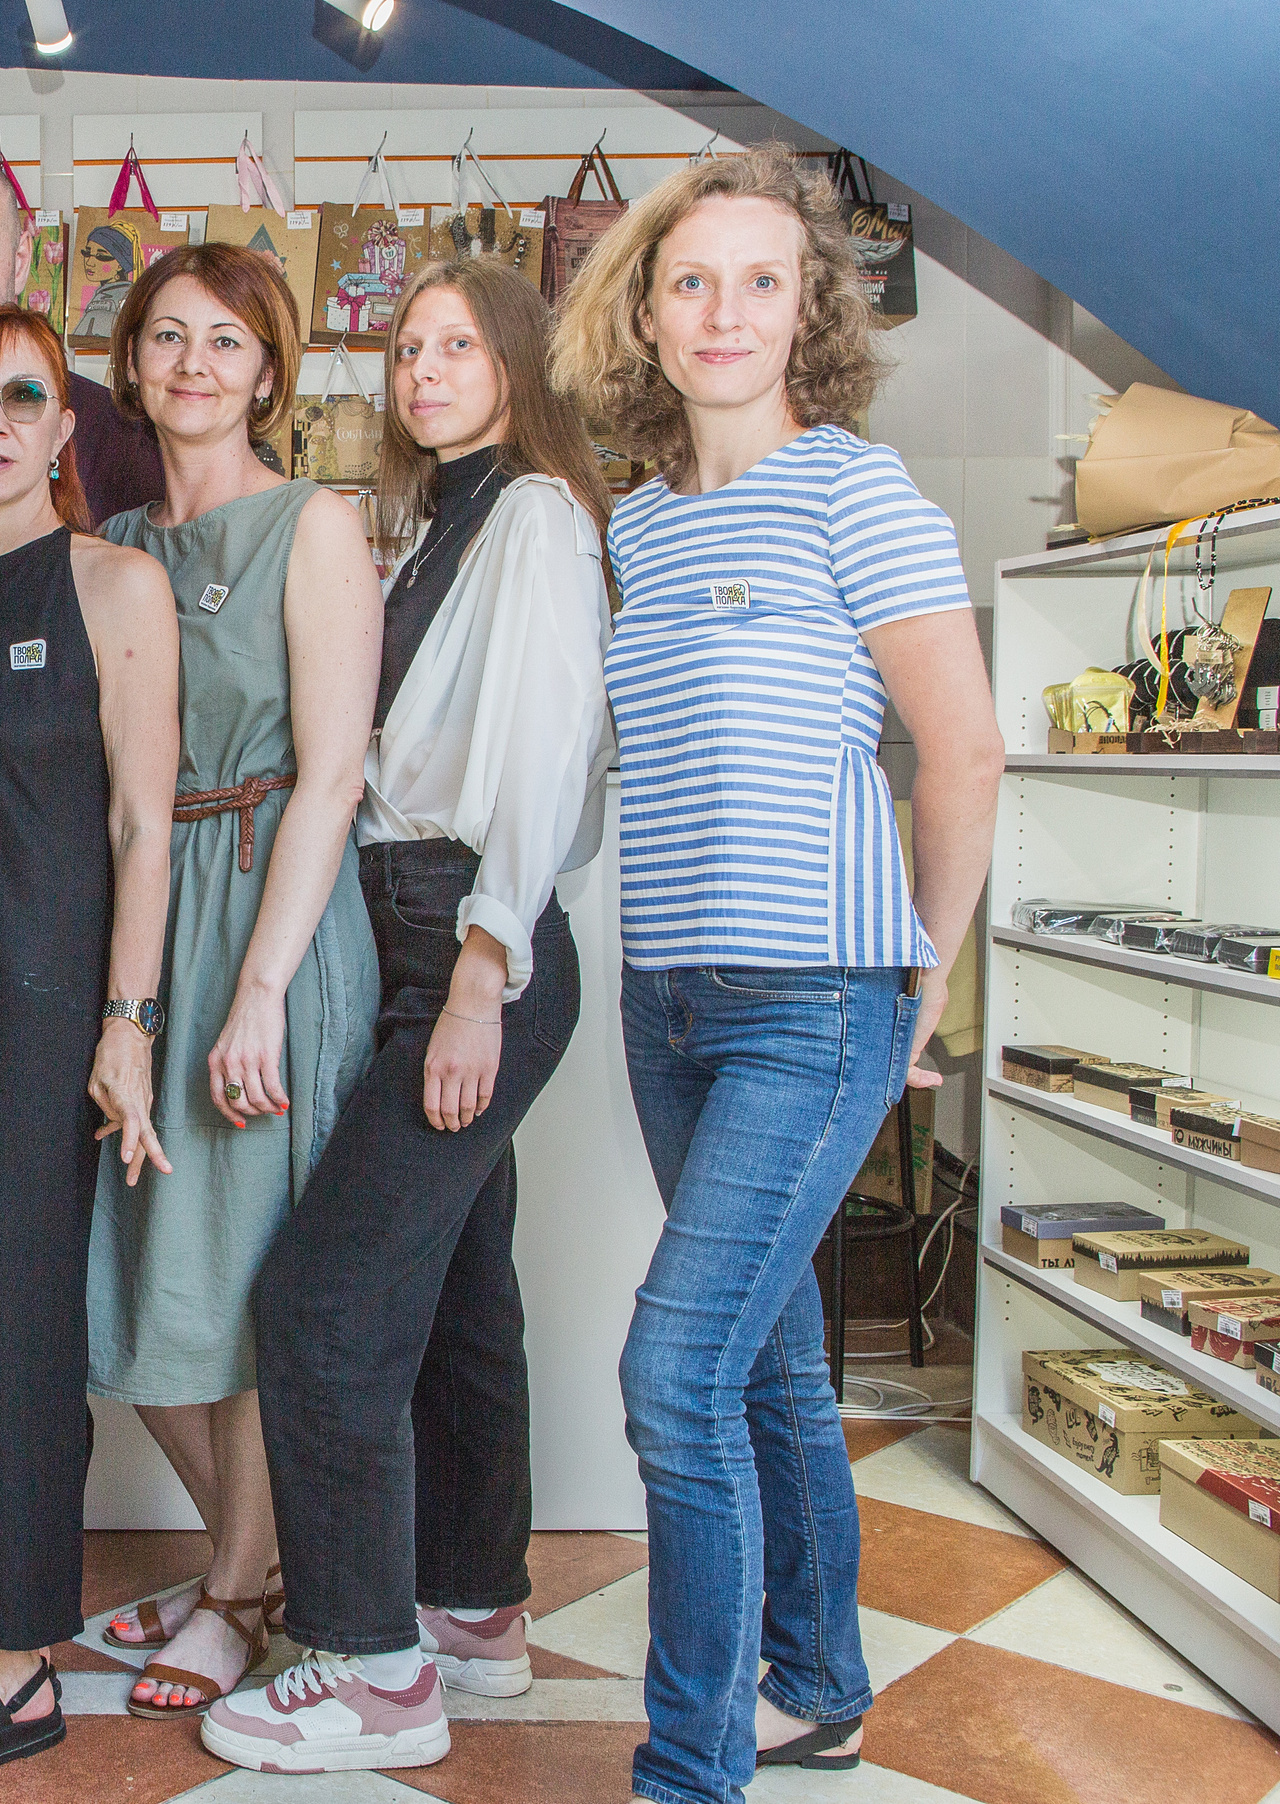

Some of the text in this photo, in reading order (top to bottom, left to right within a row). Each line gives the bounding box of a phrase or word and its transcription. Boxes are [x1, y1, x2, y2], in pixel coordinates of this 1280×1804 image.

[713, 586, 733, 596] ТВОЯ
[715, 595, 746, 605] ПОЛКА
[13, 645, 31, 655] ТВОЯ
[1188, 1134, 1232, 1158] МУЖЧИНЫ
[1041, 1258, 1060, 1268] ТЫ
